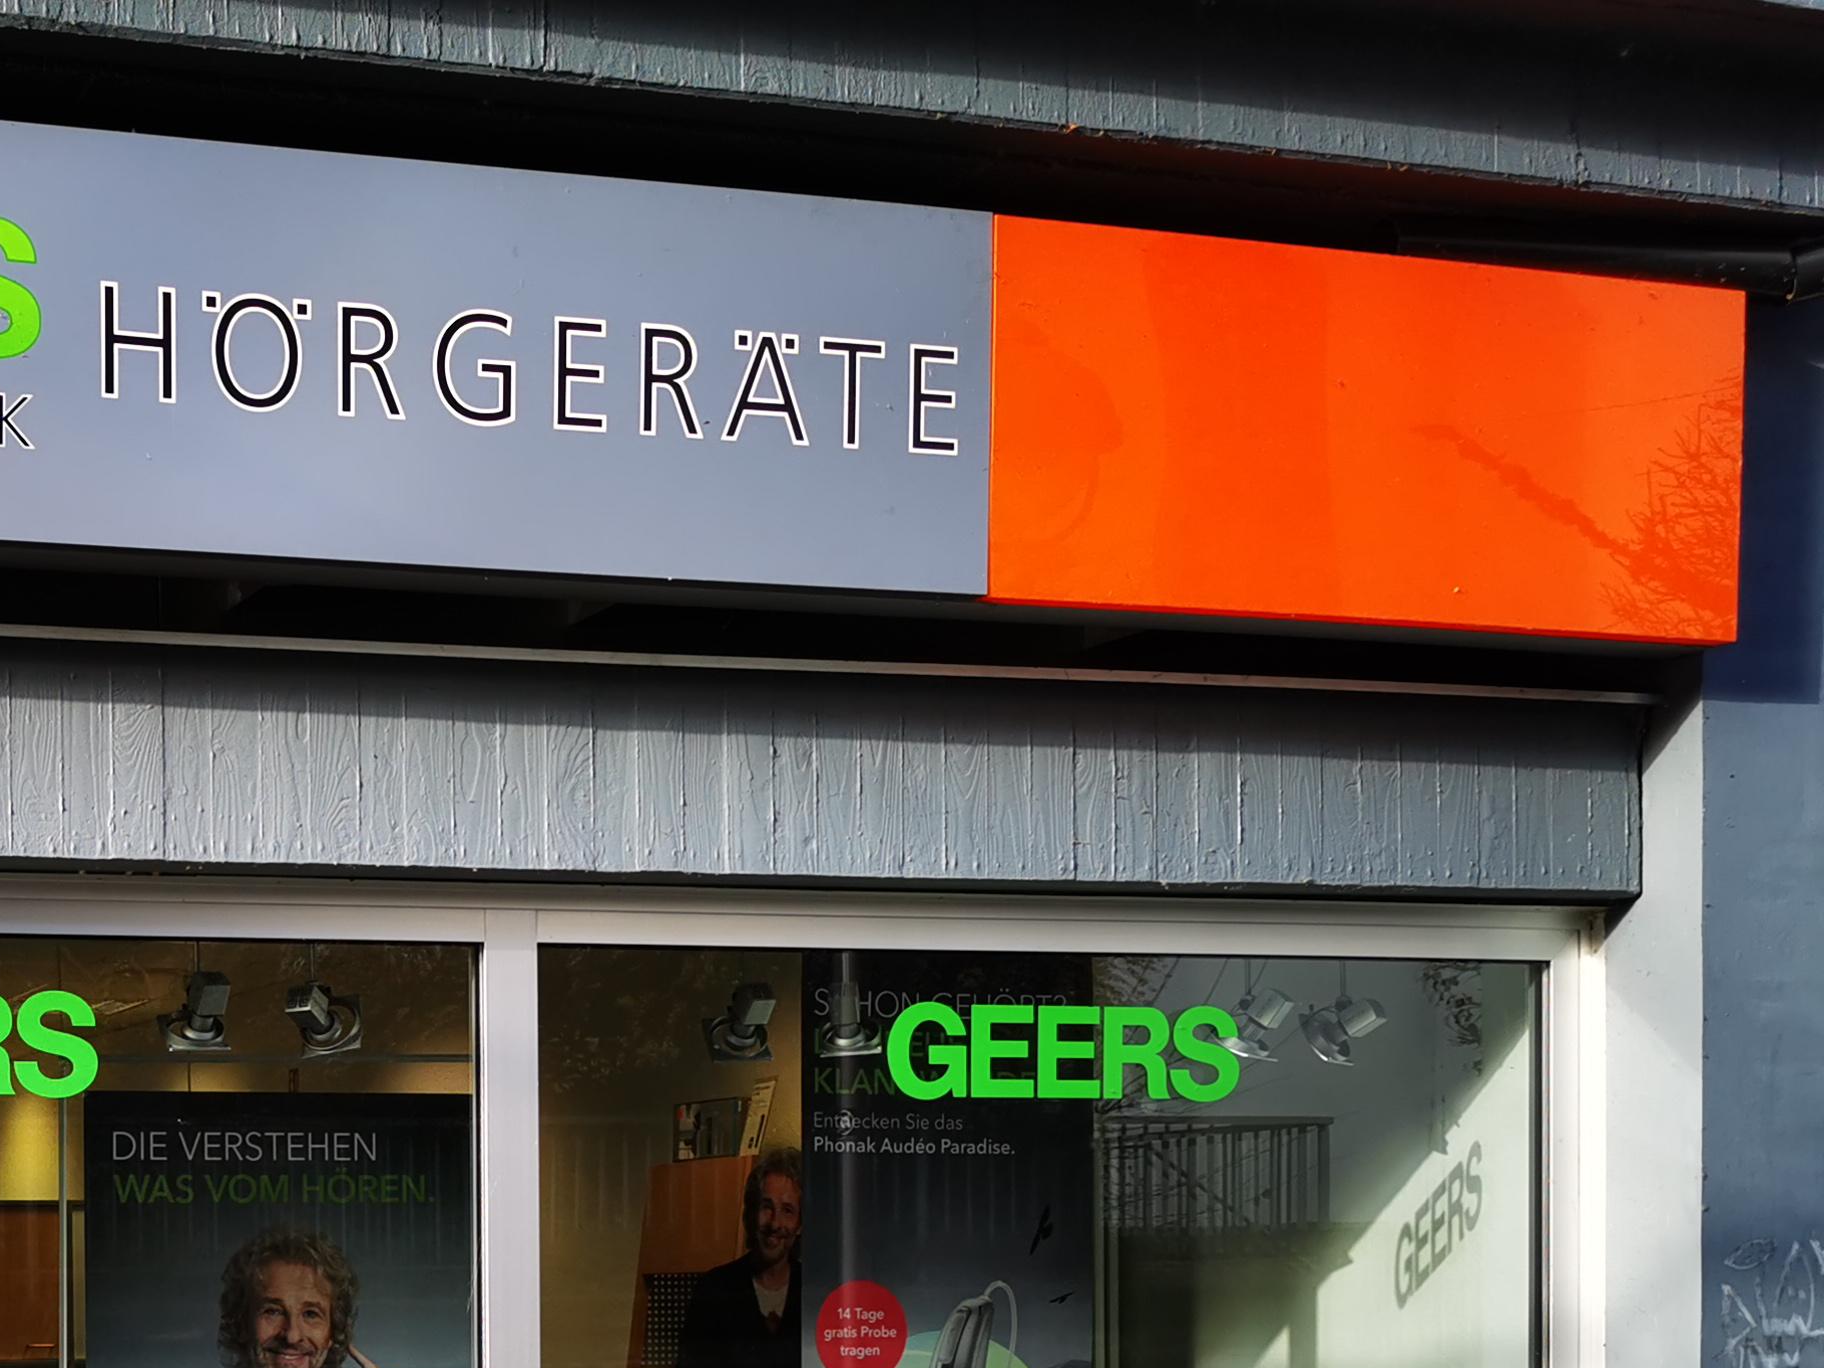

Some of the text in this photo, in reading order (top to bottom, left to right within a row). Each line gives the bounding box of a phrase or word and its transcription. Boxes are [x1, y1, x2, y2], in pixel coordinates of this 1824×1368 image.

[100, 280, 960, 457] HÖRGERÄTE
[814, 988, 919, 1018] SHON
[887, 1001, 1240, 1101] GEERS
[905, 1113, 929, 1130] Sie
[935, 1114, 963, 1131] das
[112, 1131, 377, 1161] DIE VERSTEHEN
[814, 1136, 1015, 1155] Phonak Audéo Paradise.
[113, 1167, 435, 1204] WAS VOM HÖREN.
[837, 1307, 884, 1322] 14 Tage
[824, 1326, 897, 1340] gratis Probe
[839, 1345, 880, 1359] tragen
